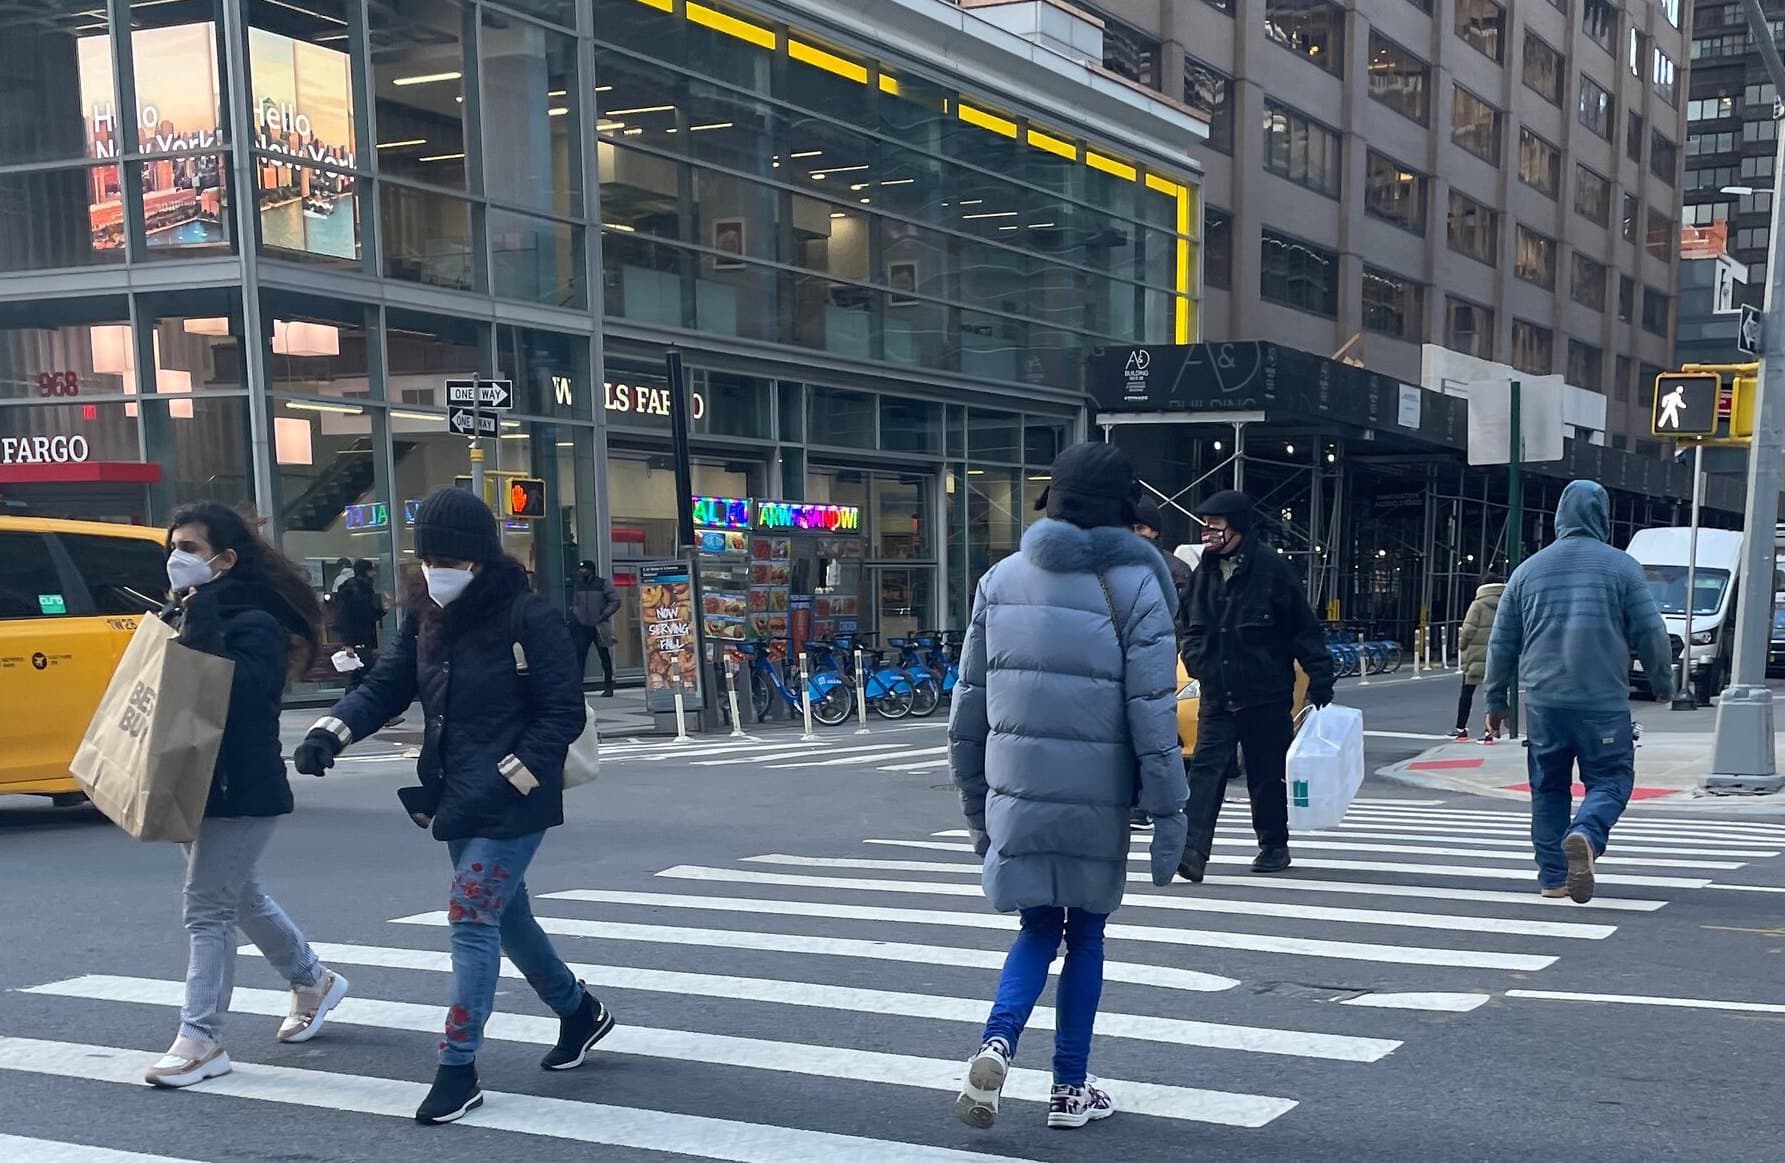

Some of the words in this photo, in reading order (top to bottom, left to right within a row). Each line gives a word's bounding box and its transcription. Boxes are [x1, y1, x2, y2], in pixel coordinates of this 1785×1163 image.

[94, 103, 157, 132] Hlo
[39, 371, 79, 397] 968
[455, 388, 474, 400] ONE
[482, 389, 501, 400] WAY
[552, 376, 630, 412] WLS
[456, 415, 472, 427] ONE
[479, 418, 492, 430] AY
[1, 435, 88, 463] FARGO
[656, 606, 679, 619] NOW
[648, 622, 689, 636] SERVING
[660, 638, 685, 651] FALL
